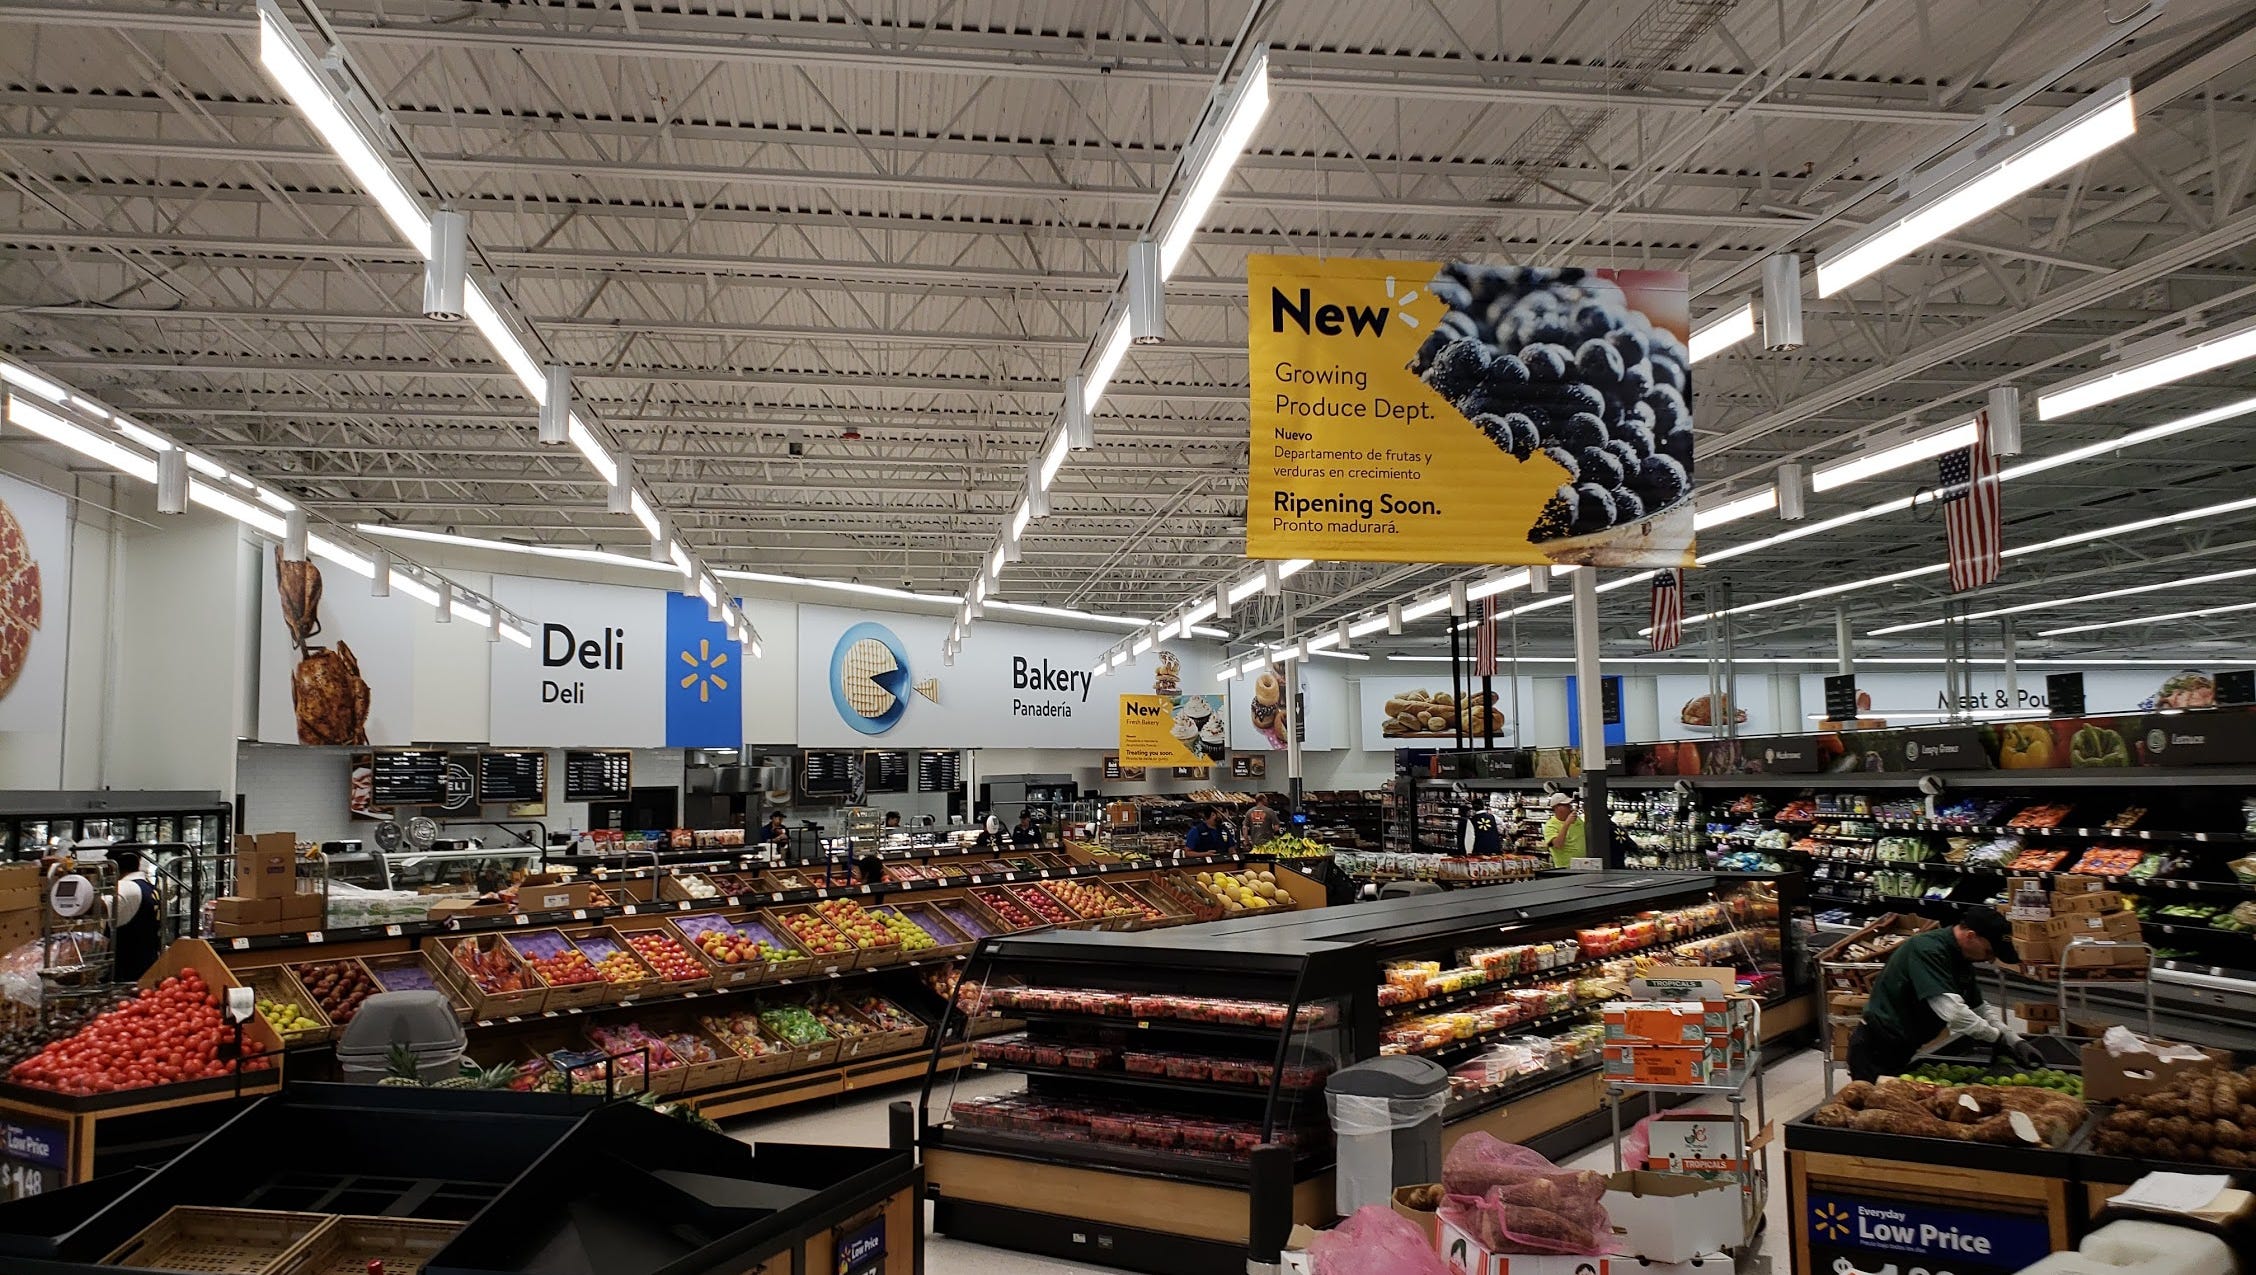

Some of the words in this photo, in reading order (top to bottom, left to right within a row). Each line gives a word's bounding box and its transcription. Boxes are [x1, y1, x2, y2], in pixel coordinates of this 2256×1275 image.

[1272, 286, 1390, 338] New
[1275, 362, 1367, 391] Growing
[1276, 394, 1367, 417] Produce
[1375, 398, 1435, 426] Dept.
[1275, 427, 1313, 441] Nuevo
[1274, 445, 1363, 462] Departamento
[1366, 448, 1382, 461] de
[1386, 449, 1421, 462] frutas
[1424, 453, 1433, 466] y
[1273, 466, 1326, 478] verduras
[1329, 468, 1344, 478] en
[1348, 467, 1421, 480] crecimiento
[1274, 490, 1373, 519] Ripening
[1380, 493, 1442, 515] Soon.
[1273, 517, 1323, 532] Pronto
[1327, 520, 1399, 534] madurará.
[543, 622, 624, 670] Deli
[1013, 656, 1093, 703] Bakery
[542, 680, 584, 704] Deli
[1995, 689, 2009, 709] &
[1013, 698, 1072, 718] Panadería
[1126, 701, 1160, 716] New
[447, 781, 466, 791] ELI
[1651, 980, 1696, 988] TROPICALS
[26, 1136, 50, 1157] Price
[1684, 1160, 1727, 1169] TROPICALS
[1857, 1205, 1906, 1223] Everyday
[1858, 1216, 1915, 1245] Low
[1919, 1223, 1992, 1255] Price
